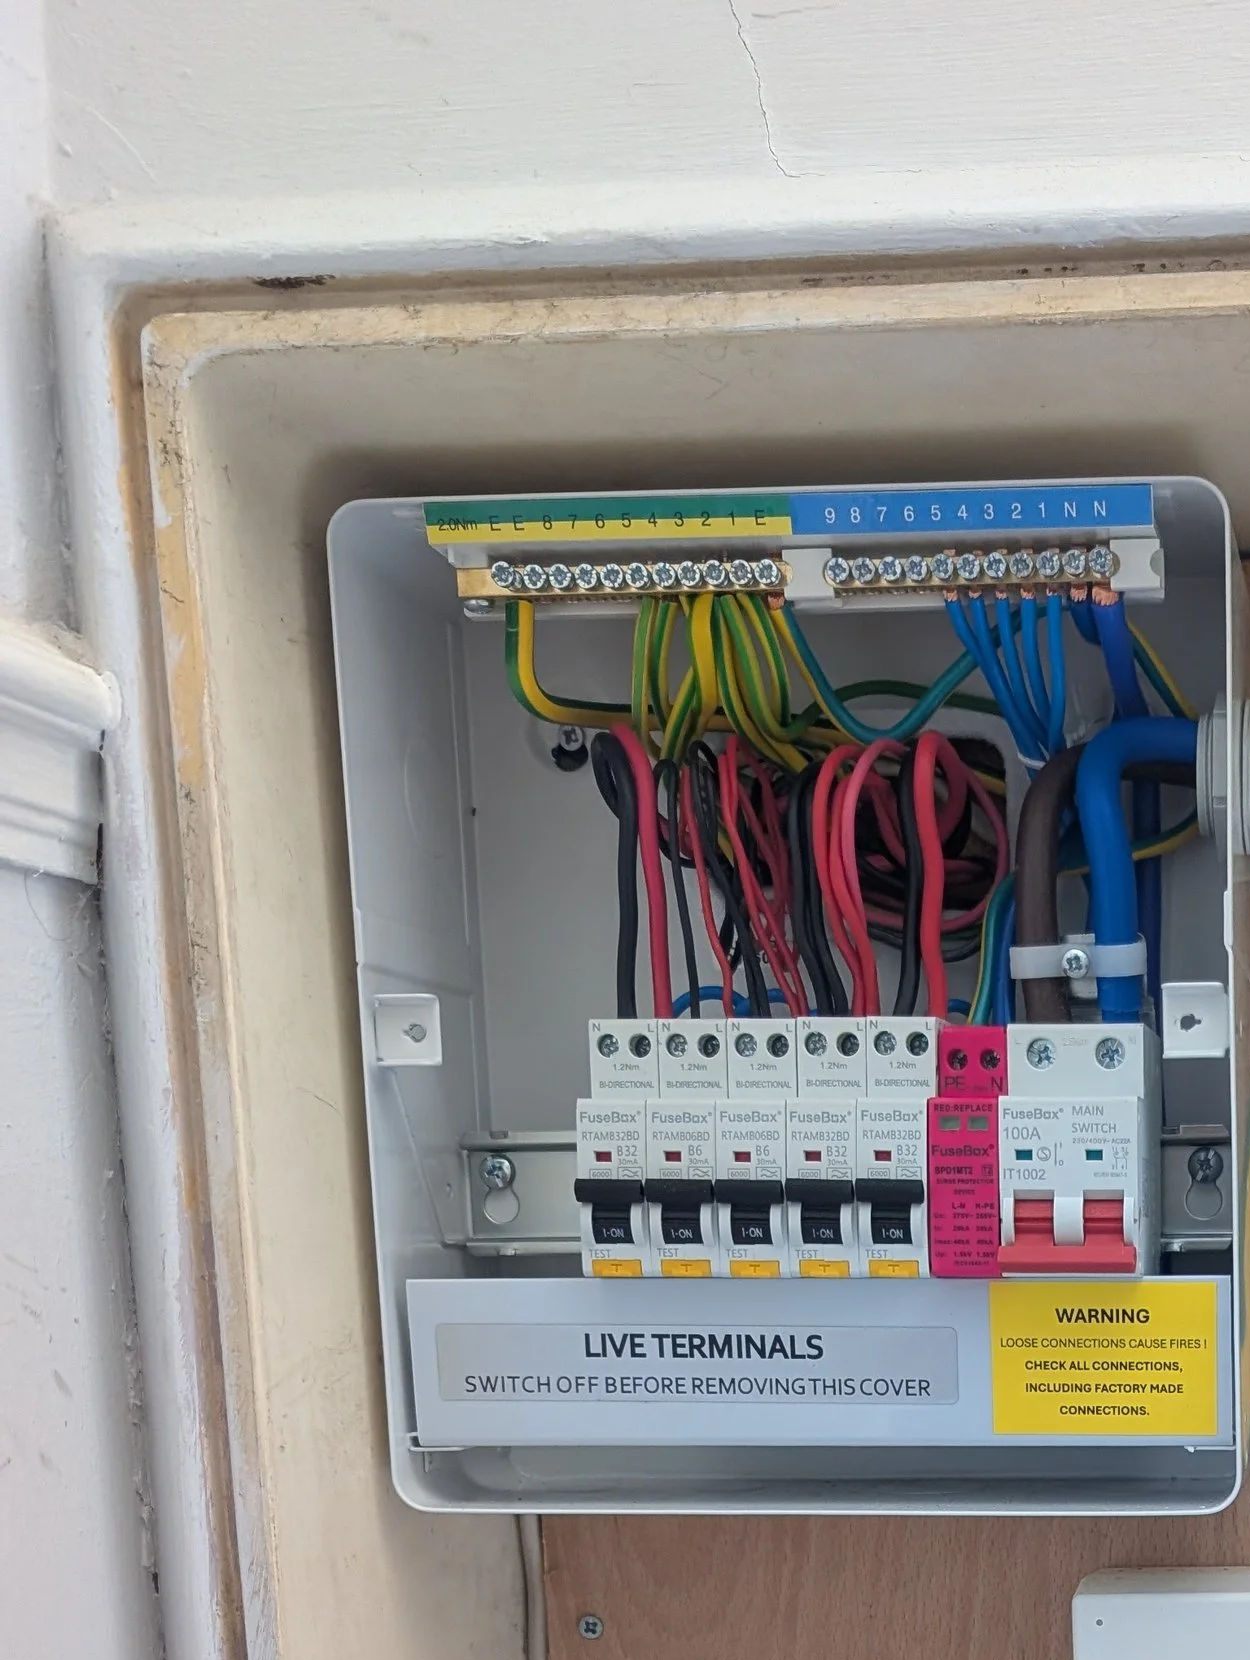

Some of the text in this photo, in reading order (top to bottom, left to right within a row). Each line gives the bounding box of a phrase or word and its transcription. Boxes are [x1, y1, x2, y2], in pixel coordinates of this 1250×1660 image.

[825, 501, 1106, 523] 9 8 7 6 5 4 3 2 1 N N
[438, 519, 477, 532] 2.0Nm
[489, 516, 502, 532] E
[513, 515, 525, 531] E
[542, 515, 552, 529] 8
[568, 514, 577, 529] 7
[595, 514, 605, 528] 6
[622, 513, 631, 528] 5
[648, 513, 658, 527] 4
[674, 512, 684, 527] 3
[702, 511, 711, 527] 2
[754, 510, 766, 526] E
[806, 1080, 862, 1088] BI-DIRECTIONAL
[875, 1079, 930, 1087] BI-DIRECTIONAL
[944, 1077, 964, 1090] PE
[1072, 1106, 1104, 1116] MAIN
[1004, 1127, 1040, 1140] 100A
[1072, 1123, 1117, 1133] SWITCH
[617, 1146, 638, 1156] B32
[688, 1146, 702, 1156] B6
[756, 1146, 769, 1156] B6
[826, 1146, 847, 1157] B32
[897, 1145, 917, 1156] B32
[1003, 1170, 1046, 1180] IT1002
[1056, 1308, 1149, 1323] WARNING
[584, 1333, 823, 1360] LIVE TERMINALS
[1000, 1338, 1201, 1349] LOOSE CONNECTIONS CAUSE FIRES
[1025, 1361, 1183, 1373] CHECK ALL CONNECTIONS,
[465, 1375, 931, 1397] SWITCH OFF BEFORE REMOVING THIS COVER
[1026, 1383, 1183, 1394] INCLUDING FACTORY MADE
[1060, 1405, 1149, 1416] CONNECTIONS.
